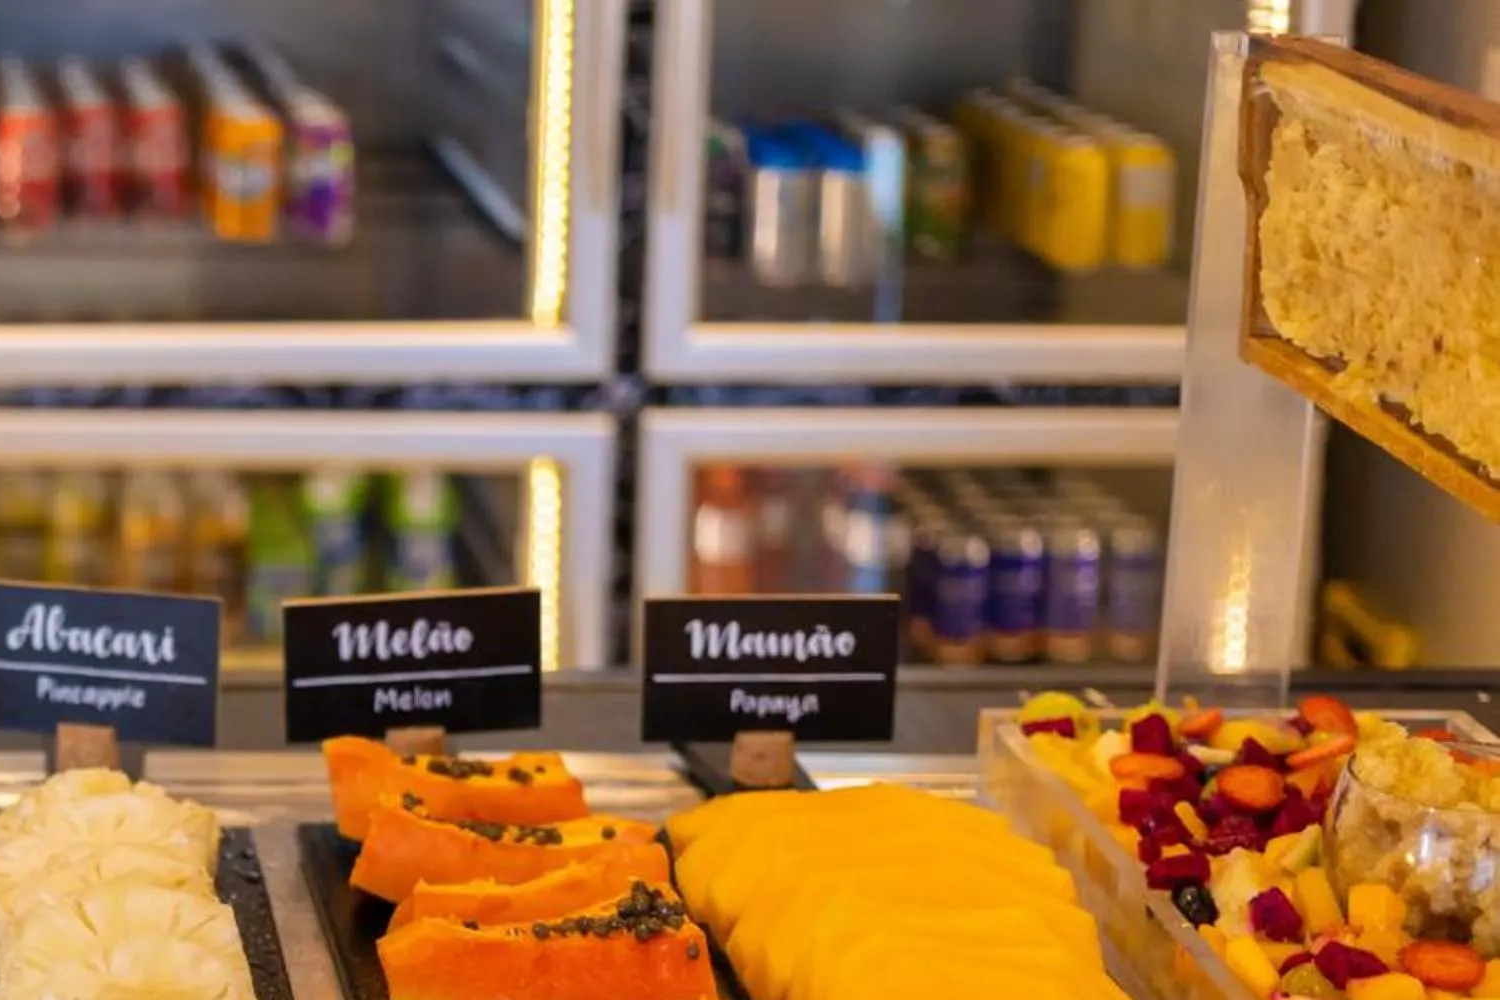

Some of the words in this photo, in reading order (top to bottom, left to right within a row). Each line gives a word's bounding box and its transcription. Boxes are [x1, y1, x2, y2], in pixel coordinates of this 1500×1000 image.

[5, 602, 177, 666] Abacaxi
[332, 618, 474, 662] Melão
[684, 618, 856, 662] Mamão
[373, 686, 453, 714] Melon
[729, 688, 820, 723] Papaya
